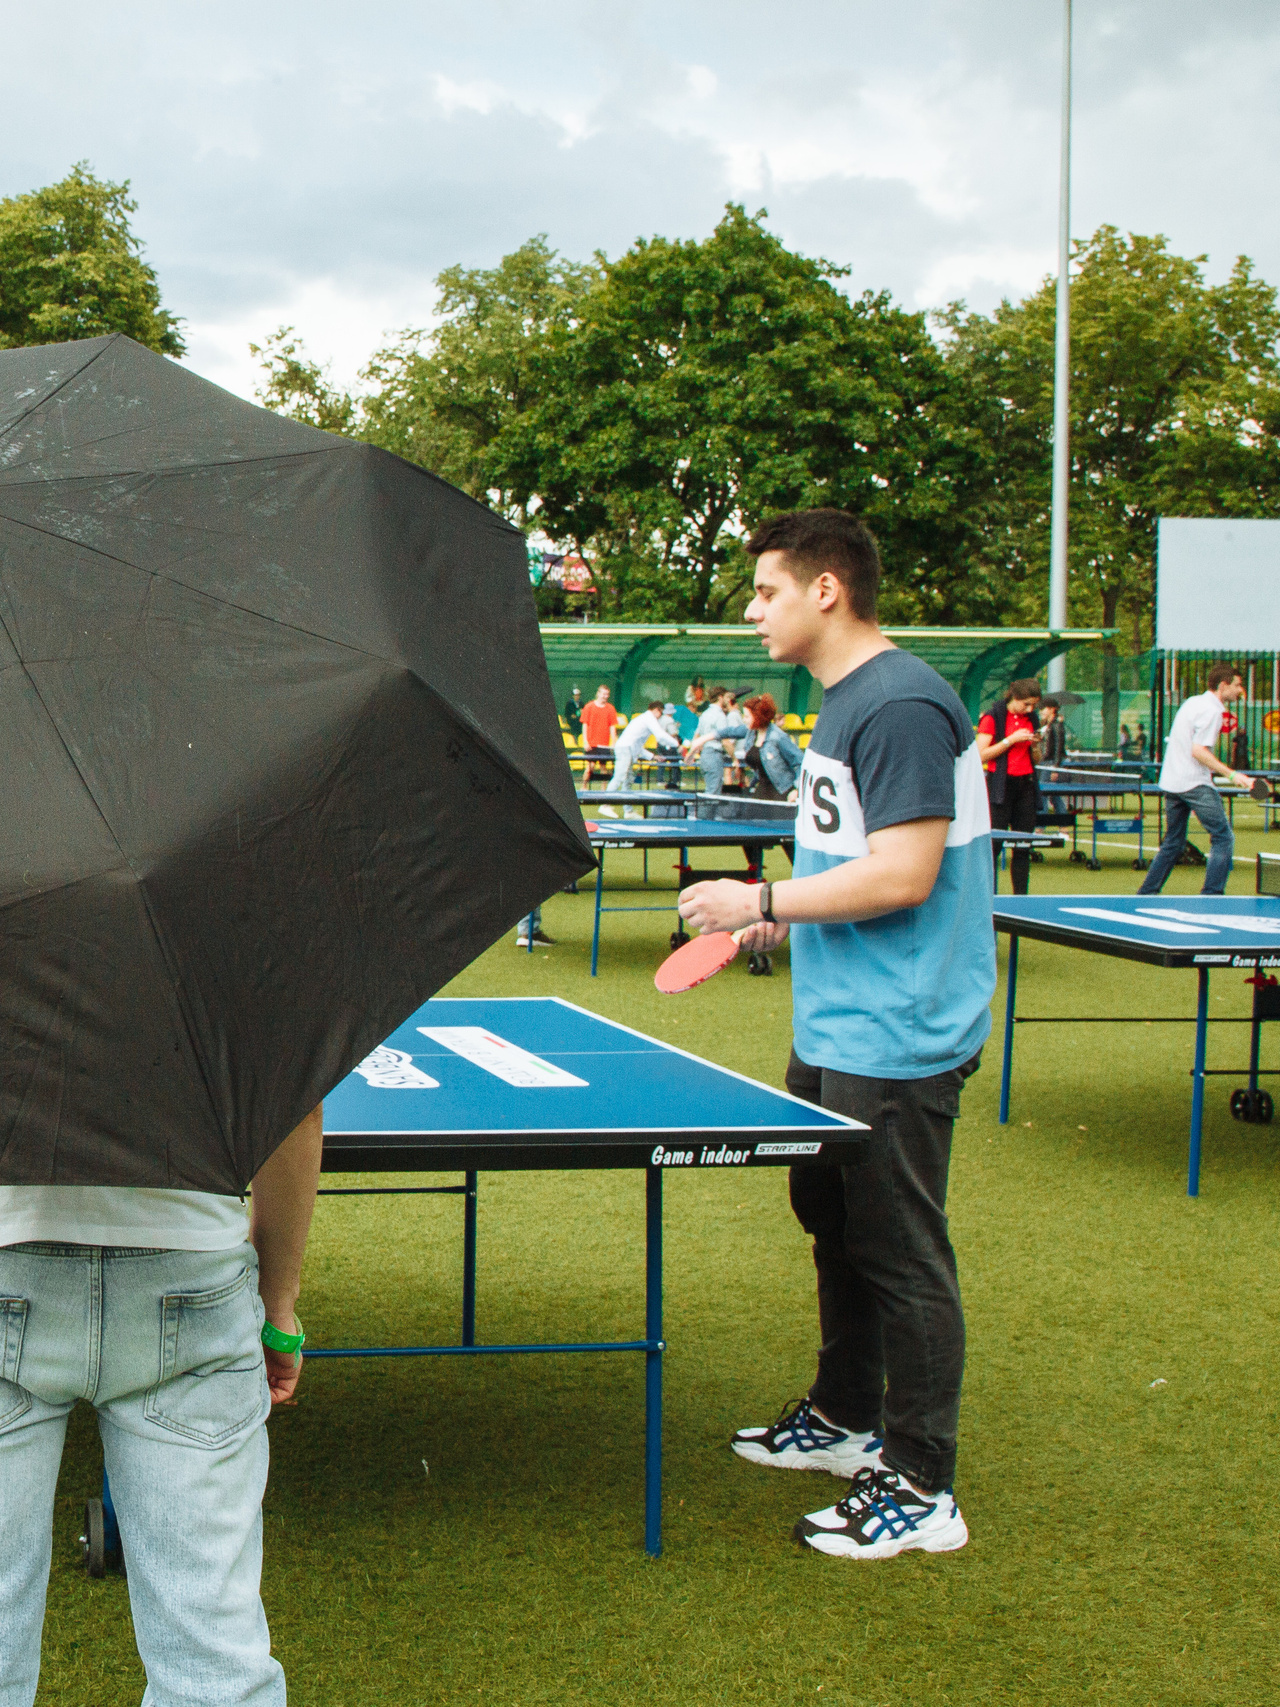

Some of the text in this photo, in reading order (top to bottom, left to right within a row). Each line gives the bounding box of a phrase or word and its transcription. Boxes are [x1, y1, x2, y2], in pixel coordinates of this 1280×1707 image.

[651, 1144, 750, 1165] Game indoor
[758, 1144, 818, 1153] START LINE
